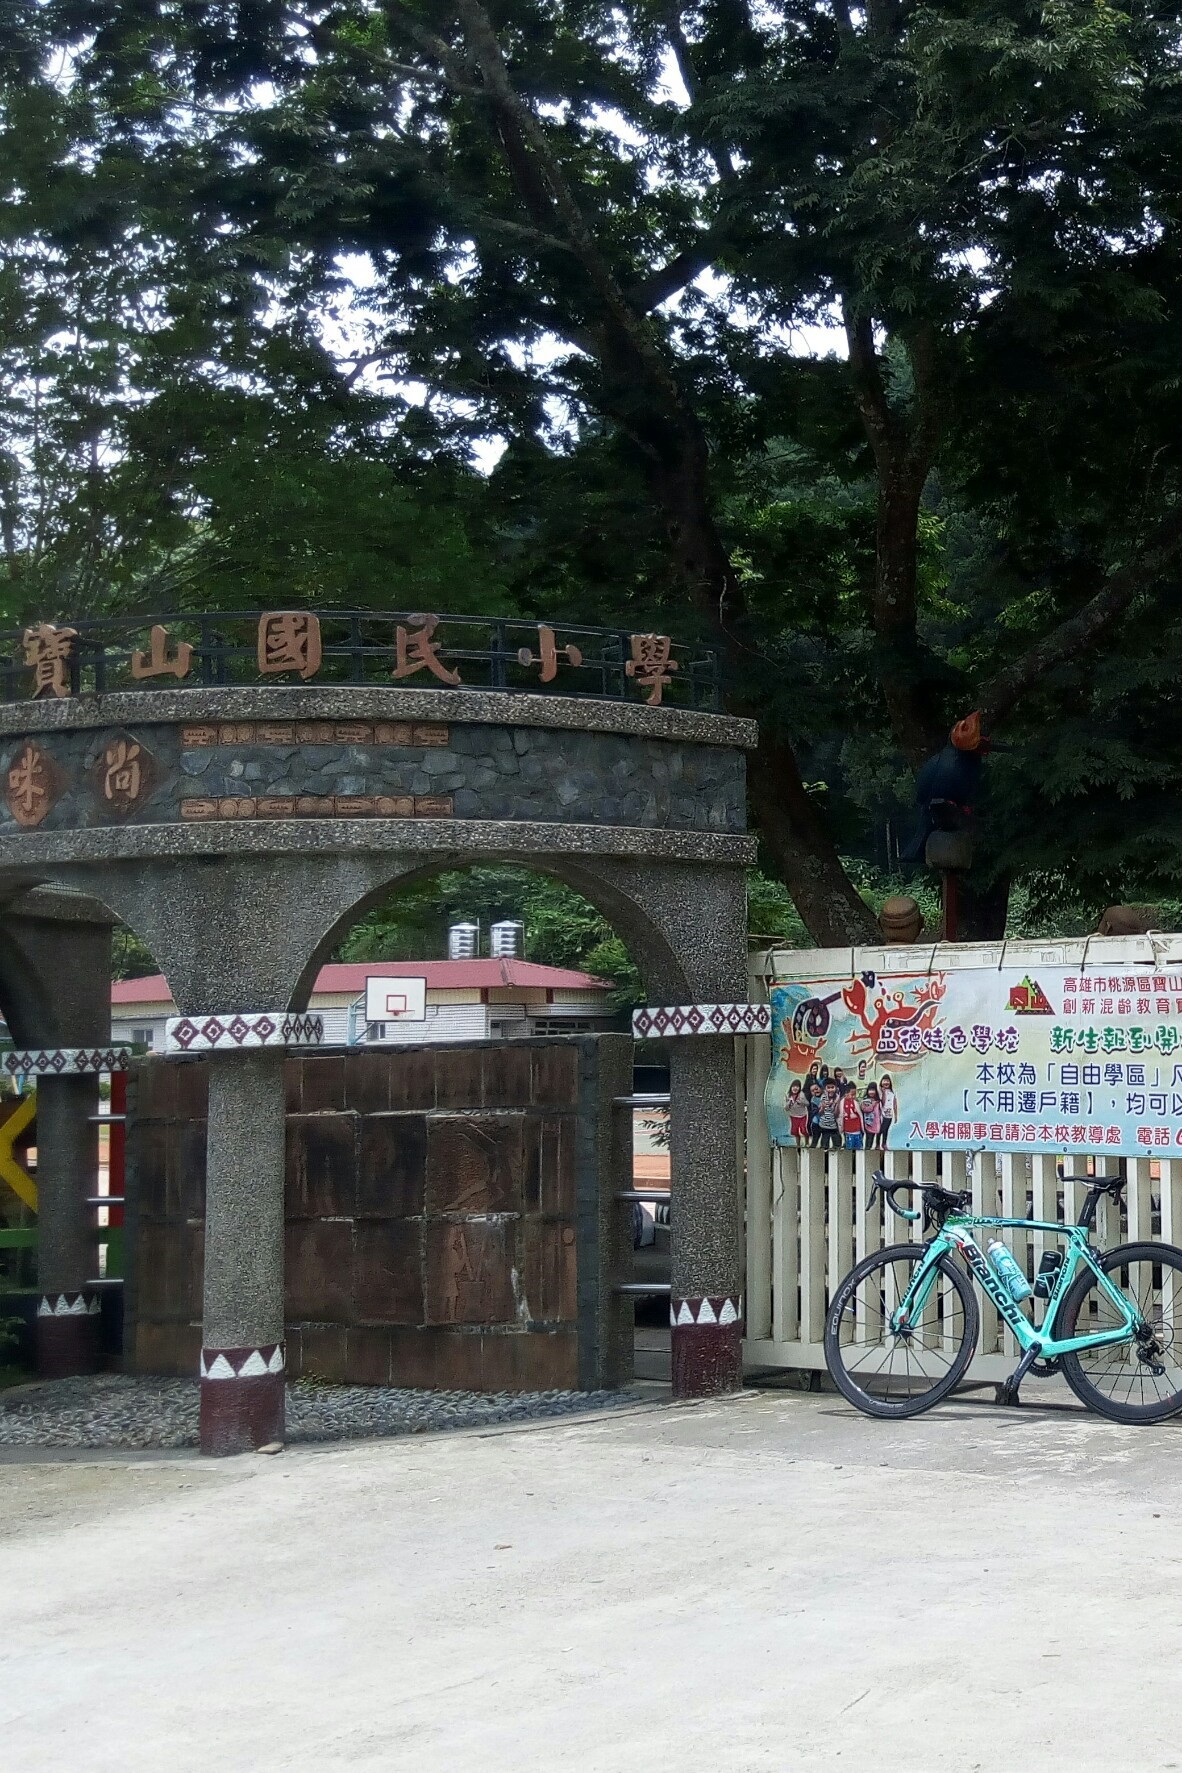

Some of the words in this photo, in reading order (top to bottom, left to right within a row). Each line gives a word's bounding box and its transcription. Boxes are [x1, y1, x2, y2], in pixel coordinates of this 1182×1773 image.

[22, 610, 679, 705] 寶山國民小學
[877, 1024, 1020, 1053] 品德特色學校
[909, 1121, 1122, 1145] 入學相關事宜請洽本校教導處
[1137, 1126, 1170, 1146] 電話
[963, 1244, 1026, 1326] Bianchi
[1052, 1256, 1071, 1301] Bianchi
[831, 1278, 856, 1336] EQUINOX
